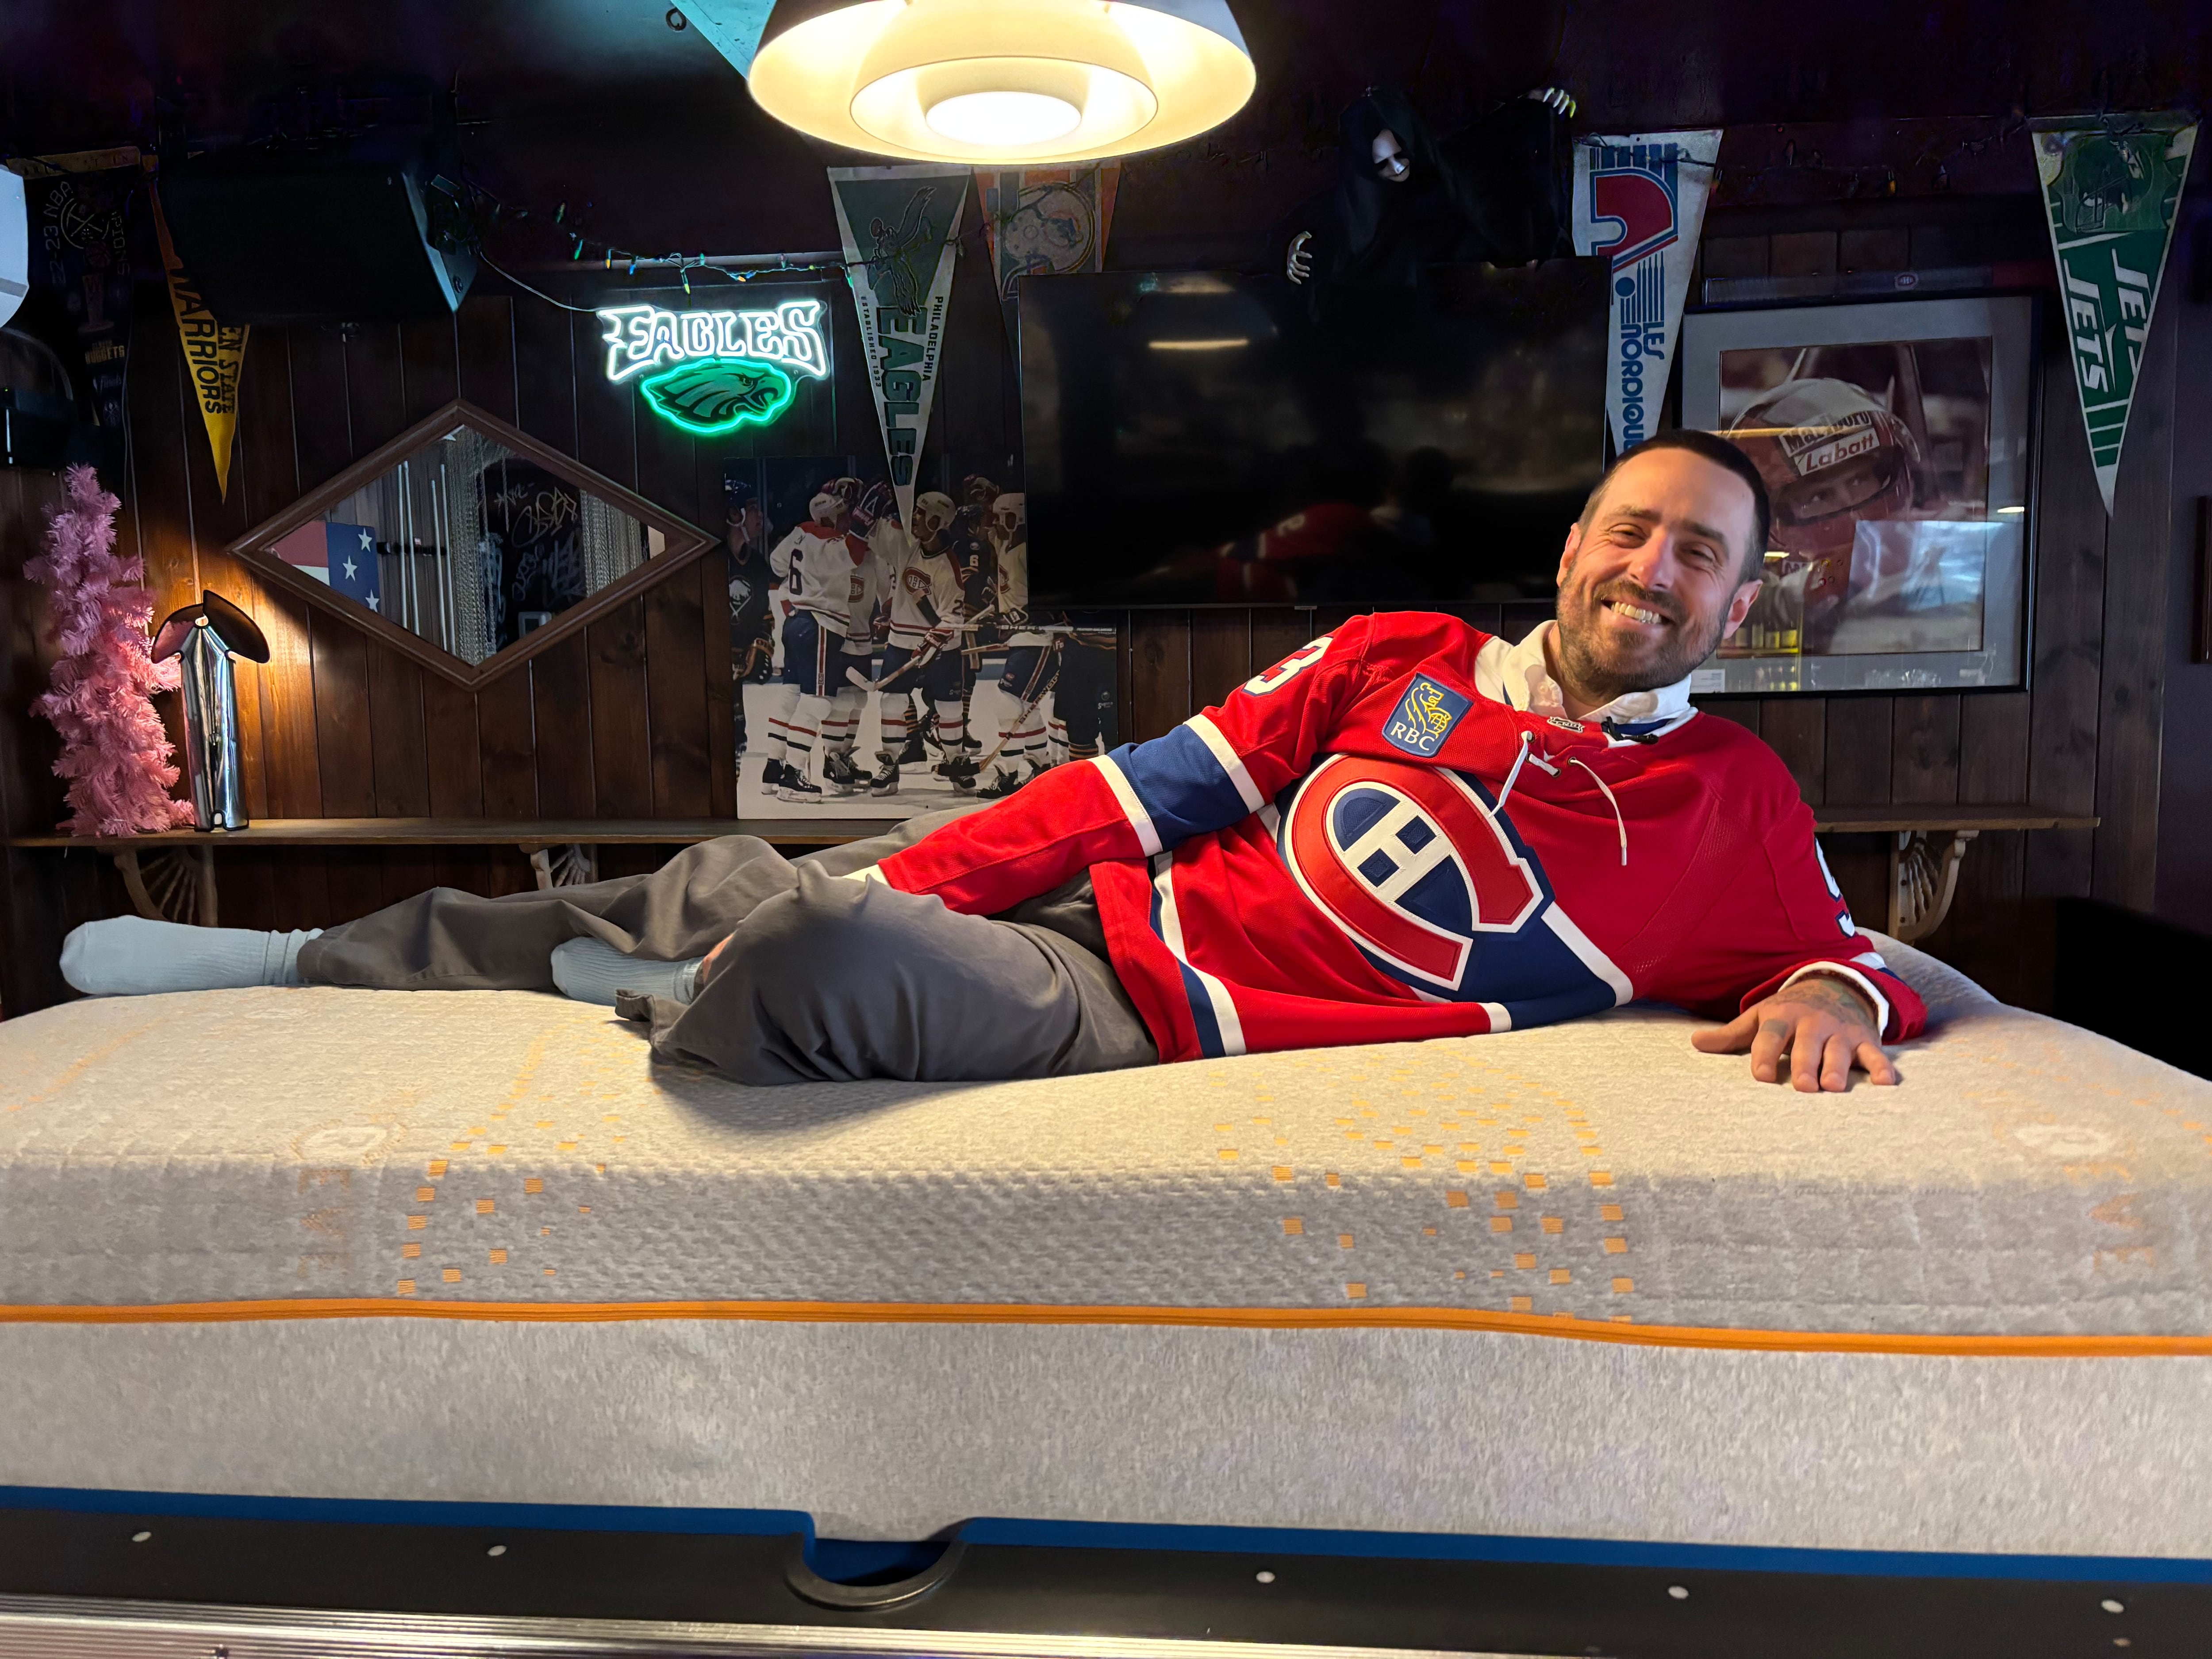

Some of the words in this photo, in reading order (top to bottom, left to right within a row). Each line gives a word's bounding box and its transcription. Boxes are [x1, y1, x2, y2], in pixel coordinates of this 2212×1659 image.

[596, 300, 828, 381] EAGLES
[861, 296, 877, 361] ESTABLISHED
[872, 365, 882, 388] 1933
[922, 296, 943, 382] PHILADELPHIA
[2063, 258, 2109, 394] JETS
[219, 360, 239, 414] STATE
[877, 306, 927, 486] EAGLES
[1806, 434, 1874, 472] Labatt
[789, 549, 803, 595] 6
[970, 555, 979, 567] 6
[1242, 636, 1333, 697] 3
[1390, 721, 1435, 752] RBC
